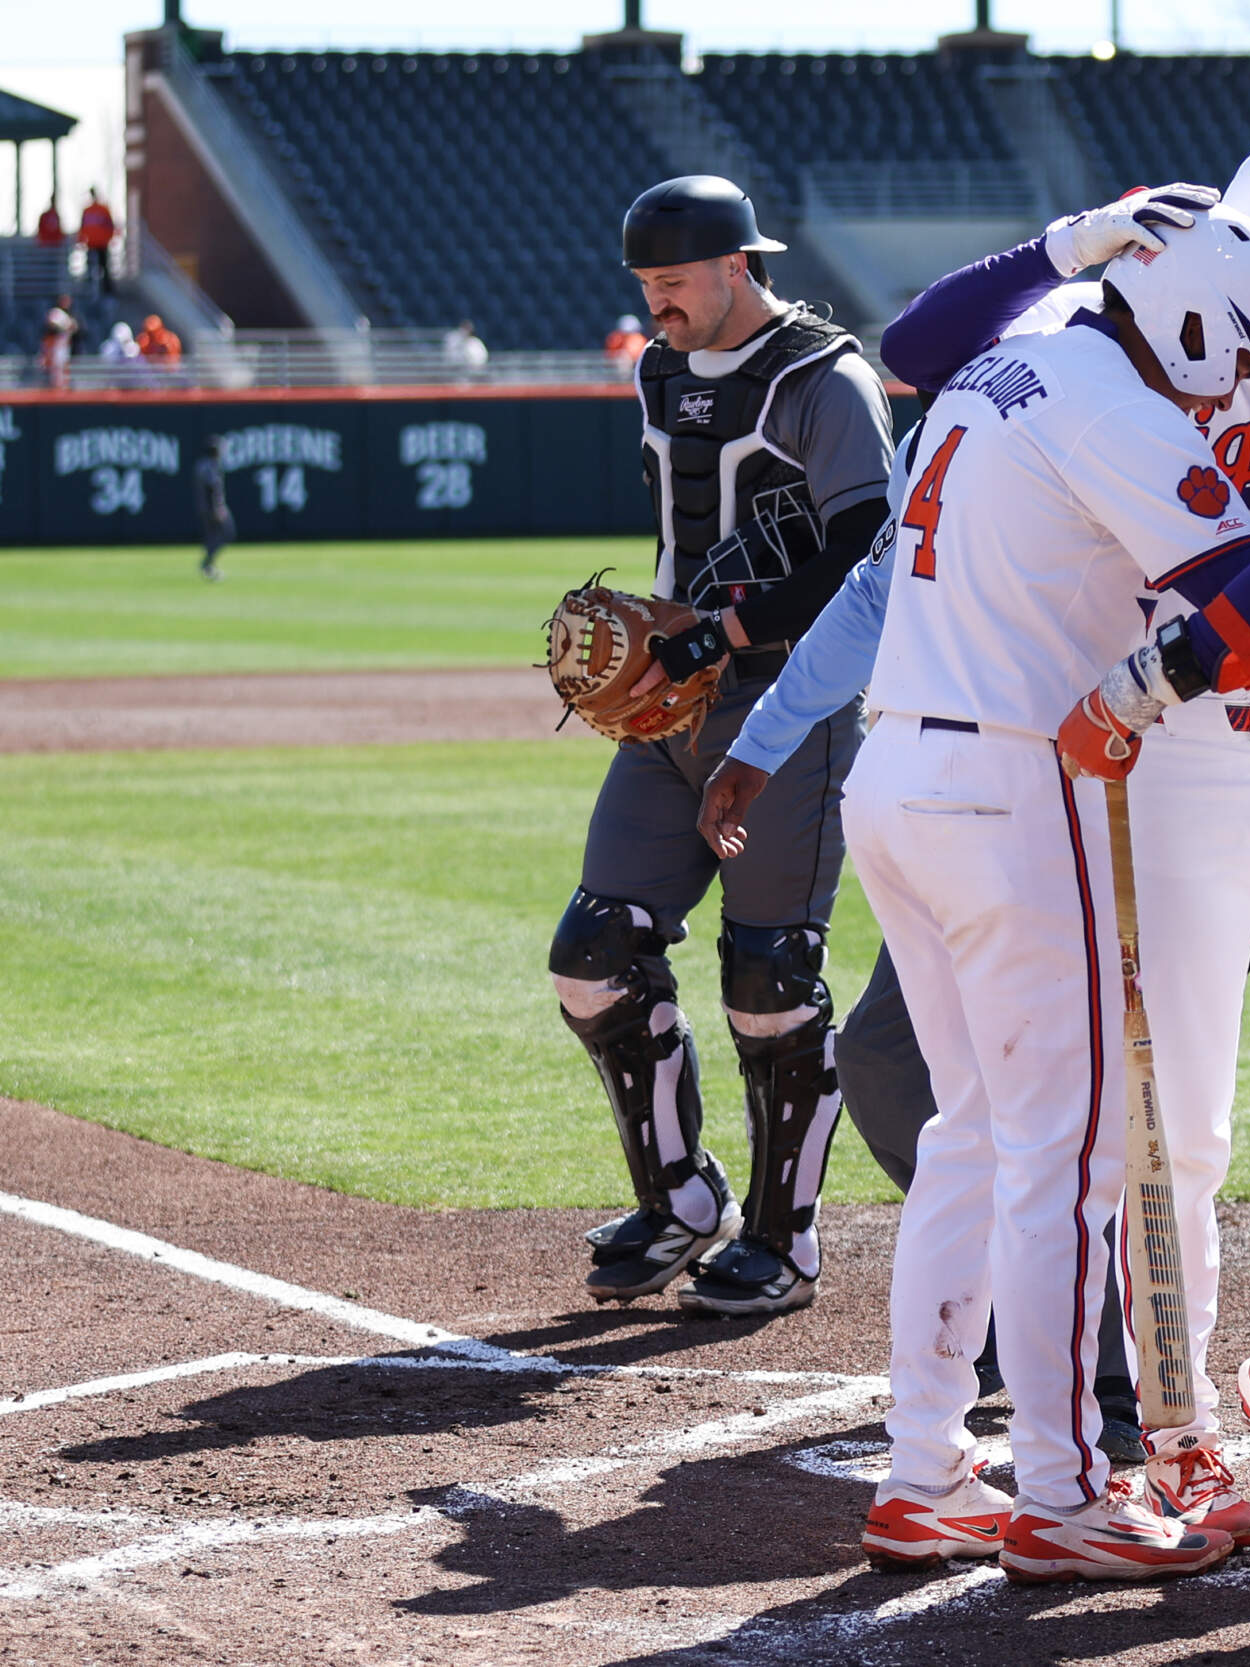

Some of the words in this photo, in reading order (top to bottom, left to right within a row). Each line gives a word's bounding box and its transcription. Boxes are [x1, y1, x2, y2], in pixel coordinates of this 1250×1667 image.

[940, 356, 1048, 421] CCLADDIE
[55, 426, 180, 476] BENSON
[220, 424, 342, 472] GREENE
[400, 421, 487, 465] BEER
[91, 467, 145, 515] 34
[254, 465, 308, 512] 14
[417, 463, 473, 509] 28
[901, 424, 968, 581] 4
[1141, 1081, 1156, 1131] REWIND
[1177, 1434, 1199, 1449] NIKE
